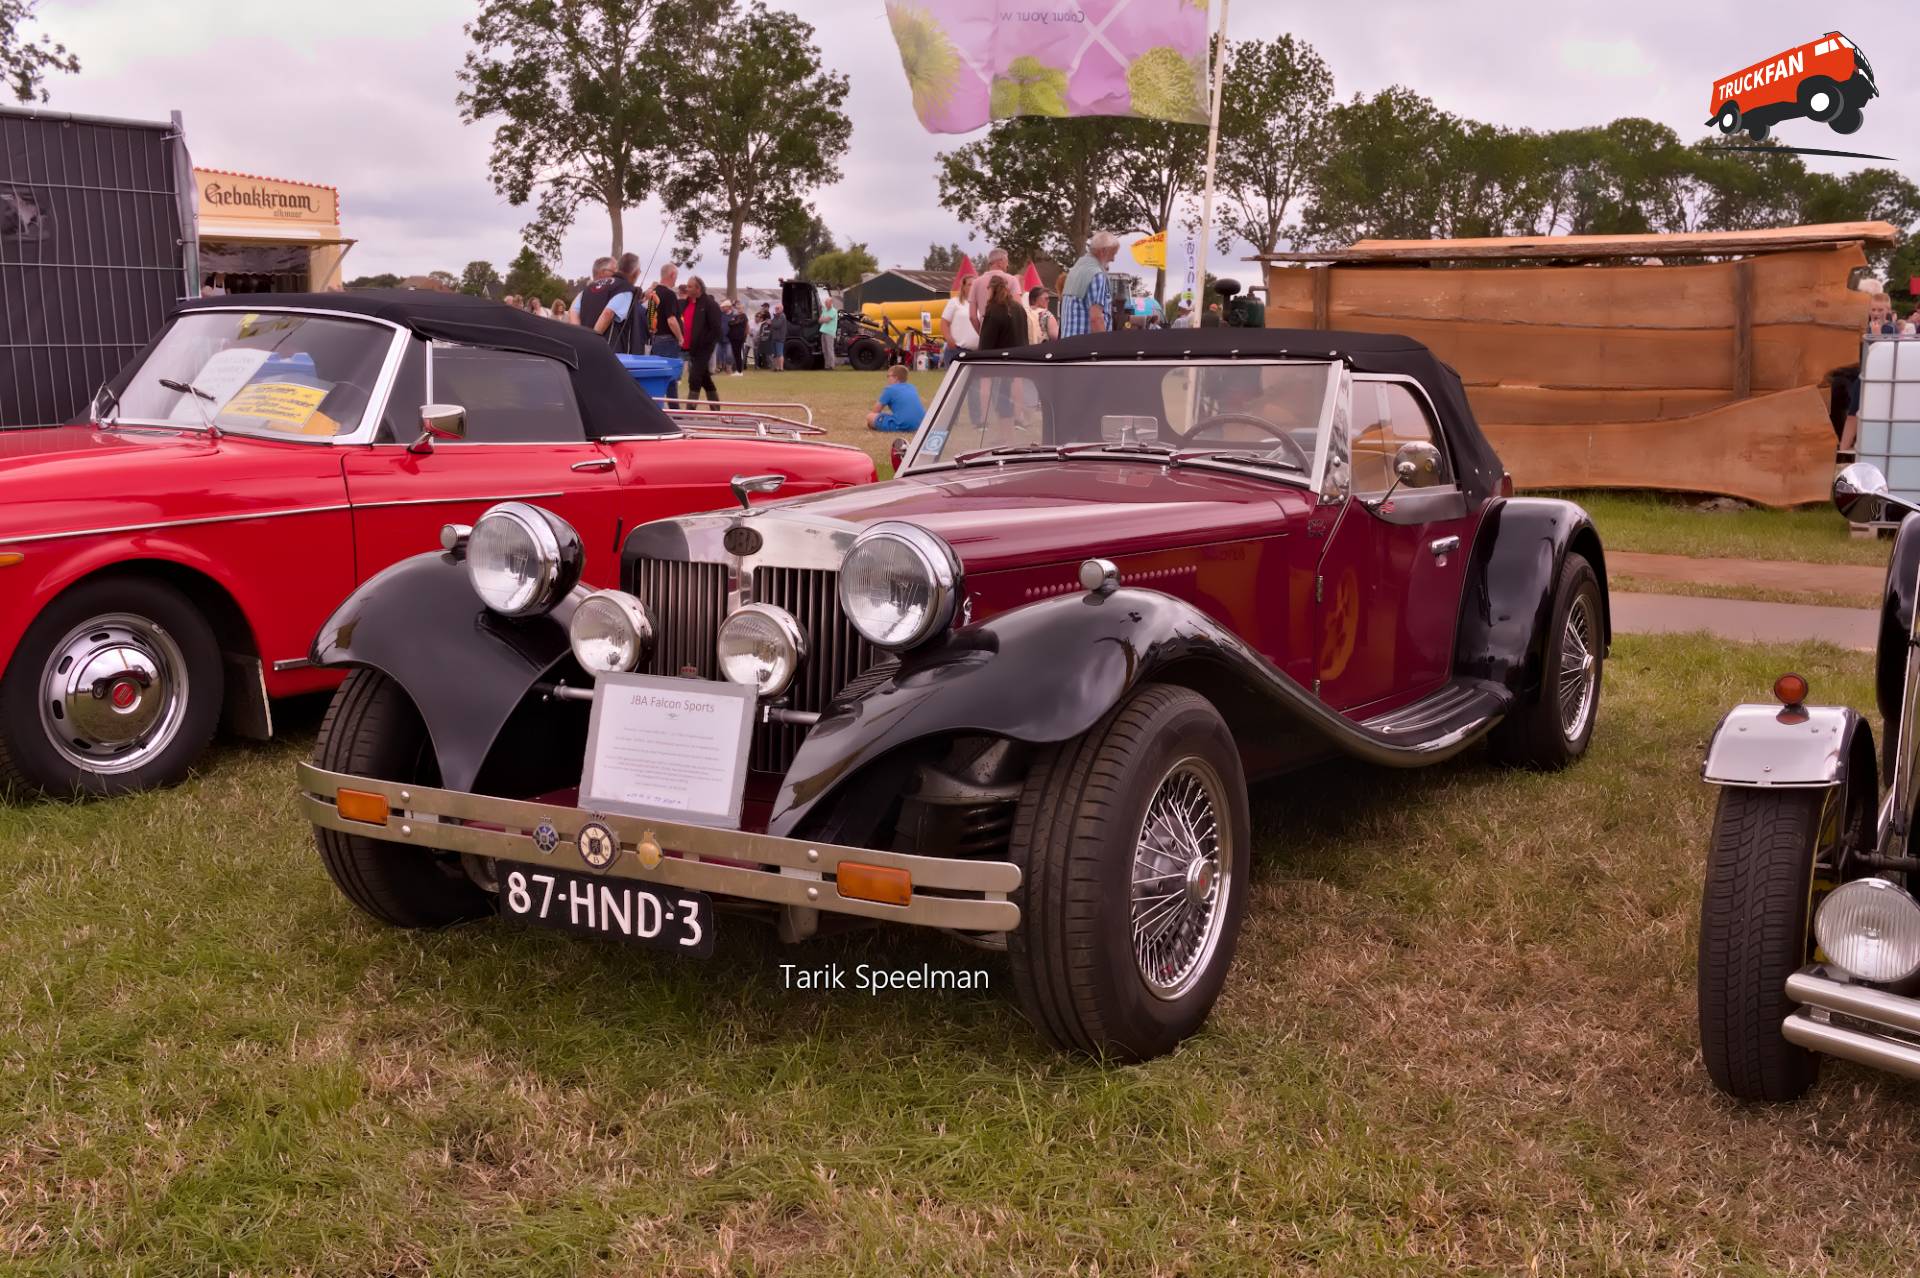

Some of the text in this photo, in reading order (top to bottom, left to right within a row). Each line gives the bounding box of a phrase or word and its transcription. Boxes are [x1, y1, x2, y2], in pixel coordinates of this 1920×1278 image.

[204, 181, 321, 213] Gebakkraam
[630, 694, 715, 713] JBA Falcon Sports
[507, 871, 702, 947] 87-HND-3
